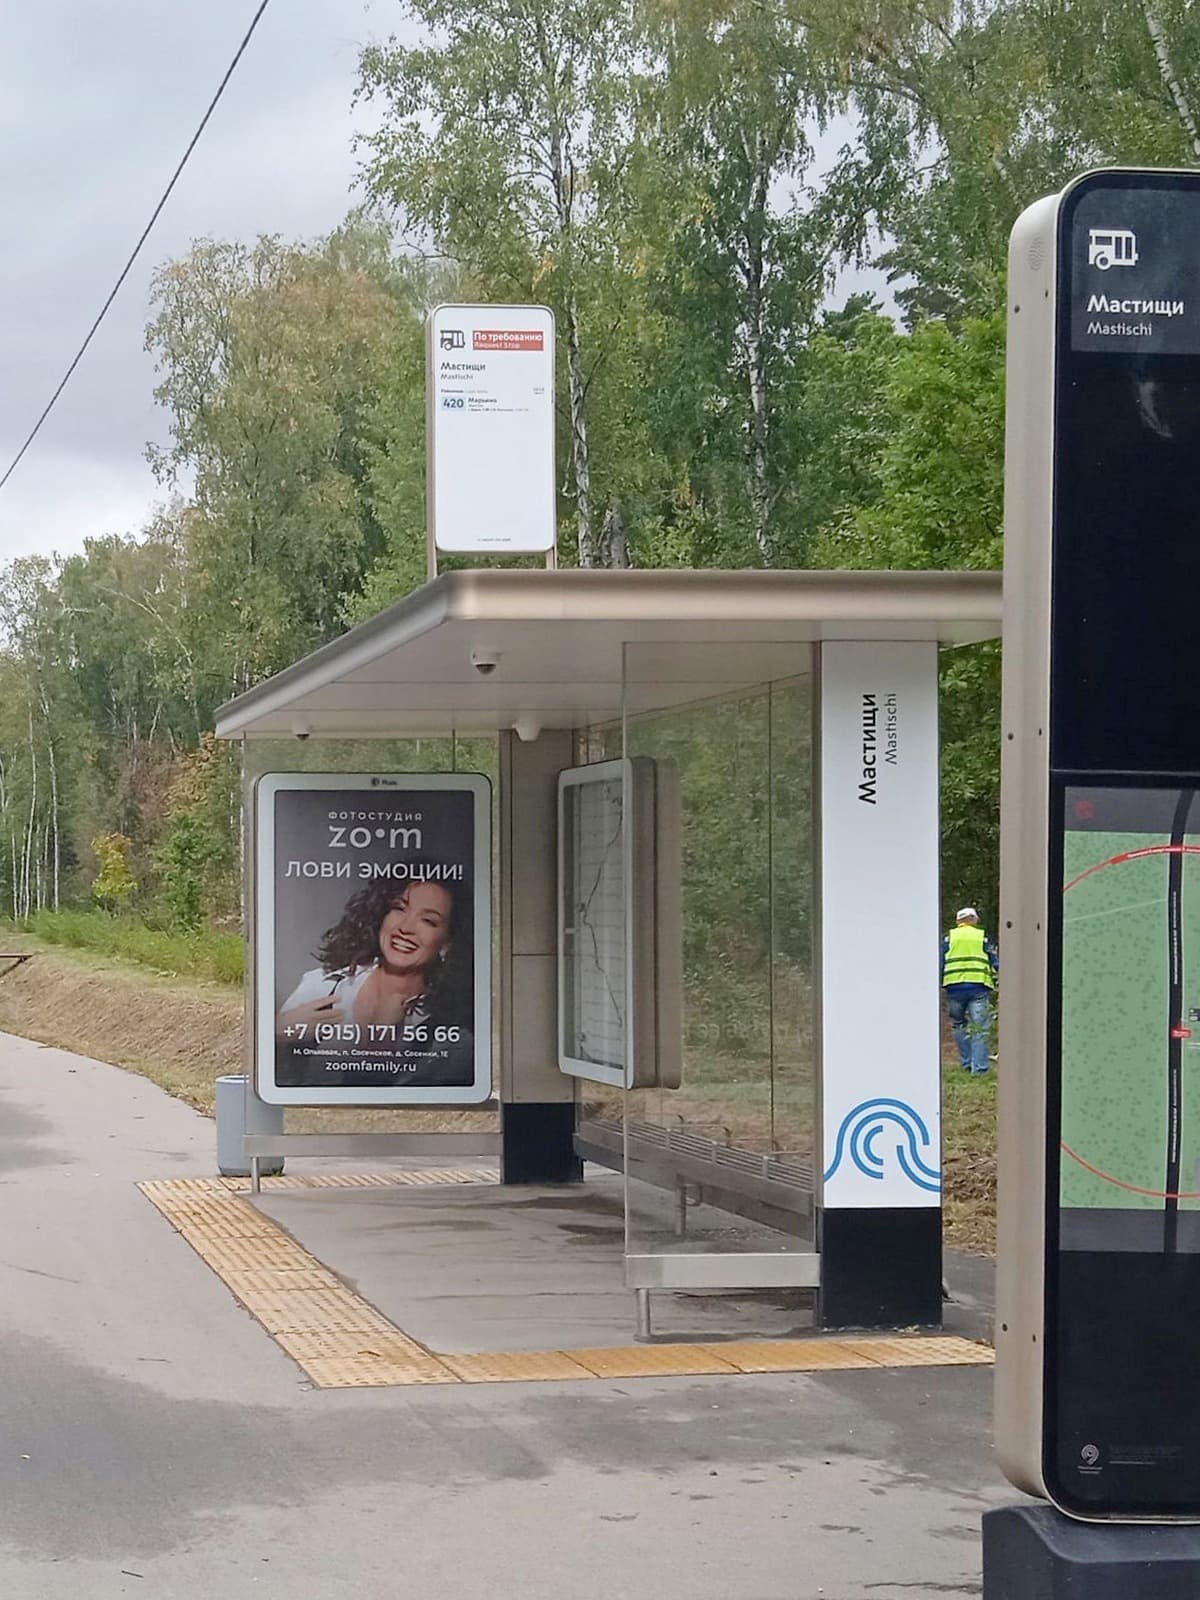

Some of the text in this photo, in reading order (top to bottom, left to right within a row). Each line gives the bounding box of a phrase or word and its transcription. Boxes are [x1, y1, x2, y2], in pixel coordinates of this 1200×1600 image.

[1087, 294, 1184, 317] Мастищи
[1087, 321, 1152, 335] Mastischi
[474, 332, 542, 343] По требованию
[440, 362, 486, 372] Мастищи
[443, 398, 464, 408] 420
[884, 693, 897, 765] Mastischi
[858, 694, 879, 805] Мастищи
[328, 811, 422, 821] ФОТОСТУДИЯ
[285, 861, 463, 882] ЛОВИ ЭМОЦИИ!
[284, 1023, 461, 1044] +7 (915) 171 56 66
[325, 1061, 417, 1074] zoomfamily.ru
